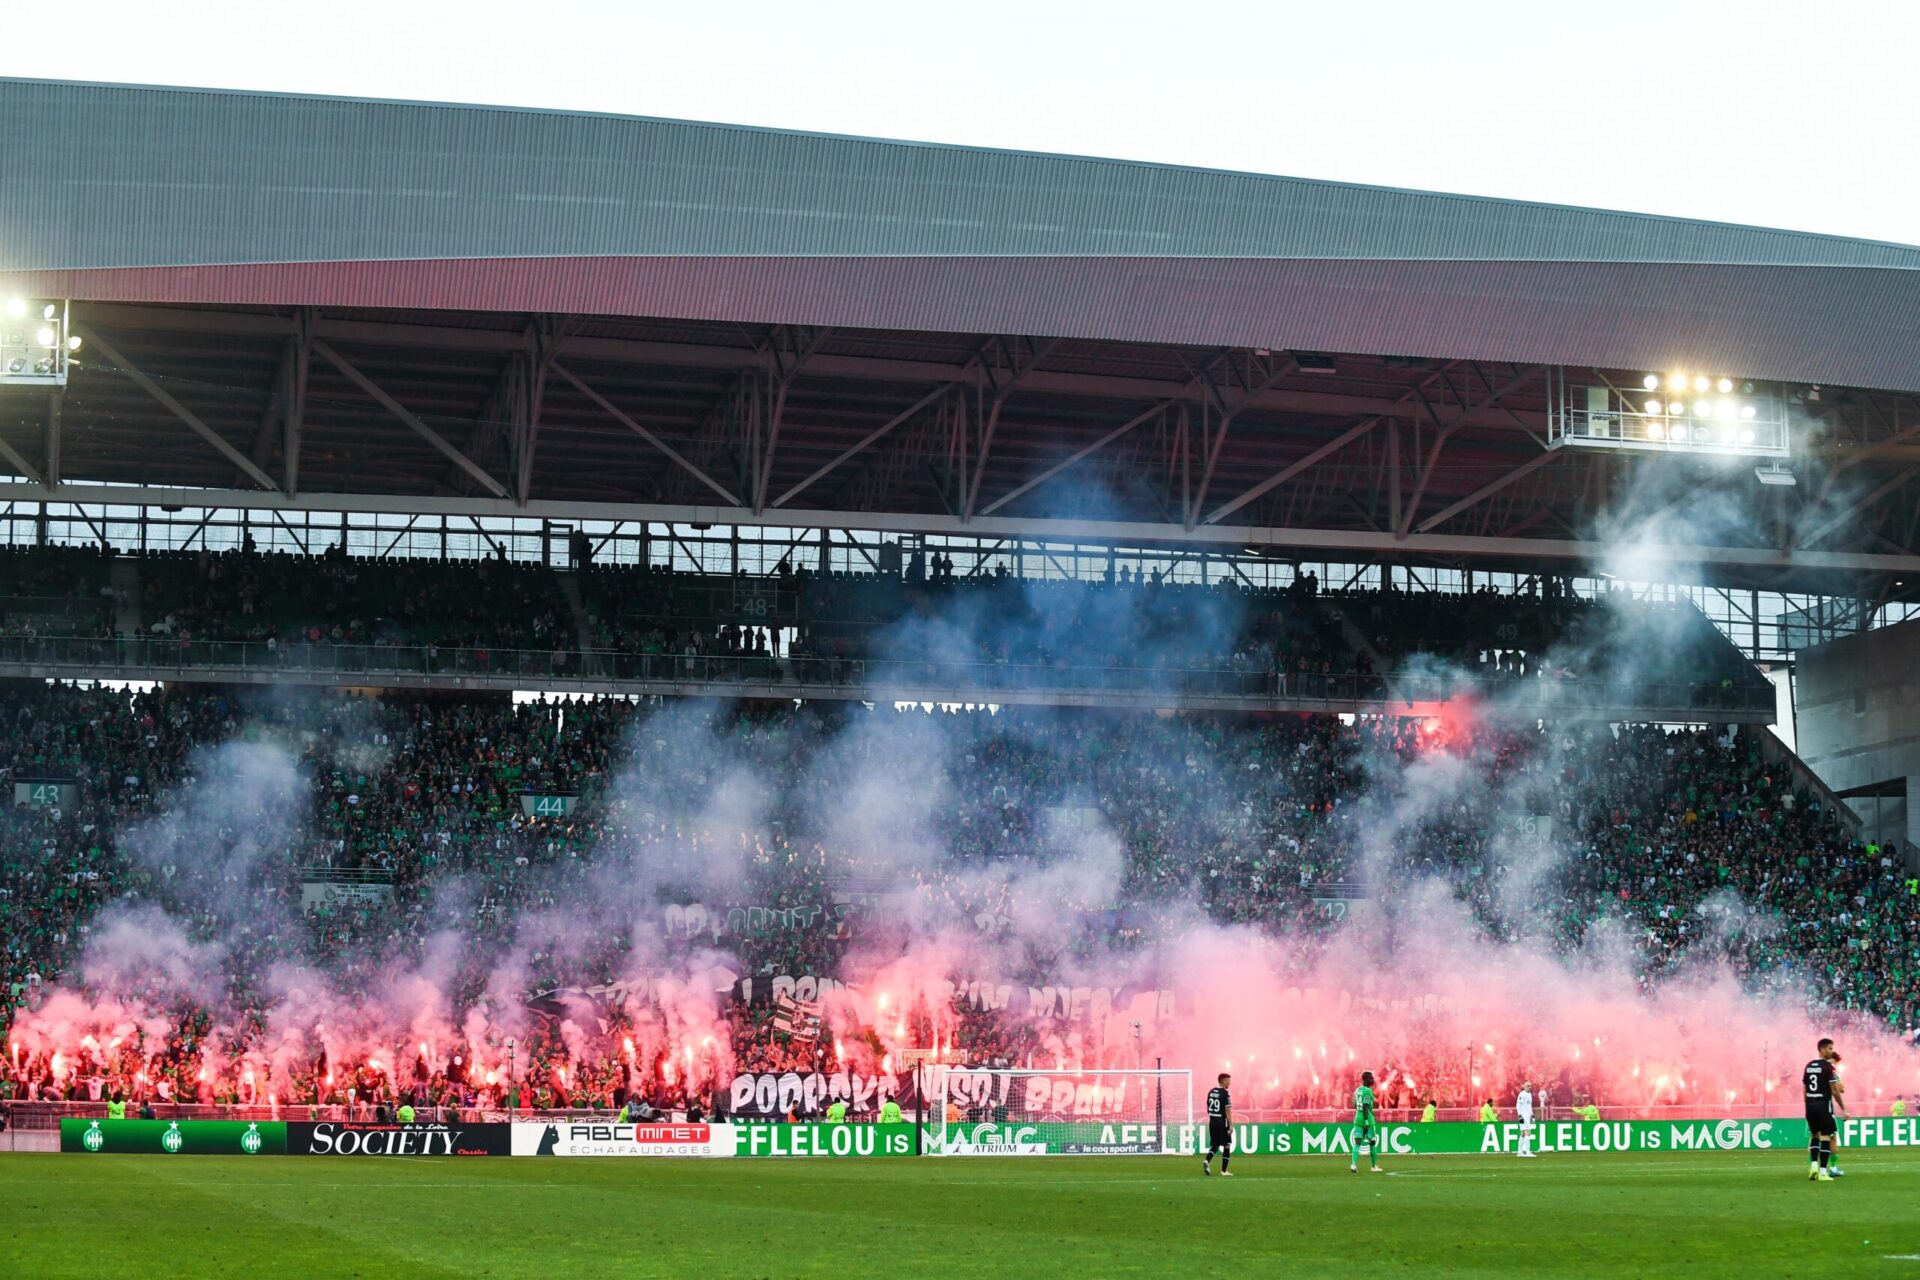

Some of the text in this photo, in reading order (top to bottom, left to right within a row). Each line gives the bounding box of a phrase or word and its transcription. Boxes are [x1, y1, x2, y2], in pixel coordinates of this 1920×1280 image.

[743, 598, 767, 616] 48
[1495, 623, 1518, 641] 49
[33, 786, 58, 804] 43
[537, 798, 564, 816] 44
[1809, 1074, 1818, 1092] 3
[1208, 1098, 1221, 1113] 29
[309, 1122, 464, 1155] SOCIETY
[570, 1126, 634, 1141] ABC
[1671, 1118, 1773, 1150] MAGIC
[570, 1145, 711, 1155] ÉCHAFAUDAGES
[973, 1144, 1018, 1154] ATRIUM
